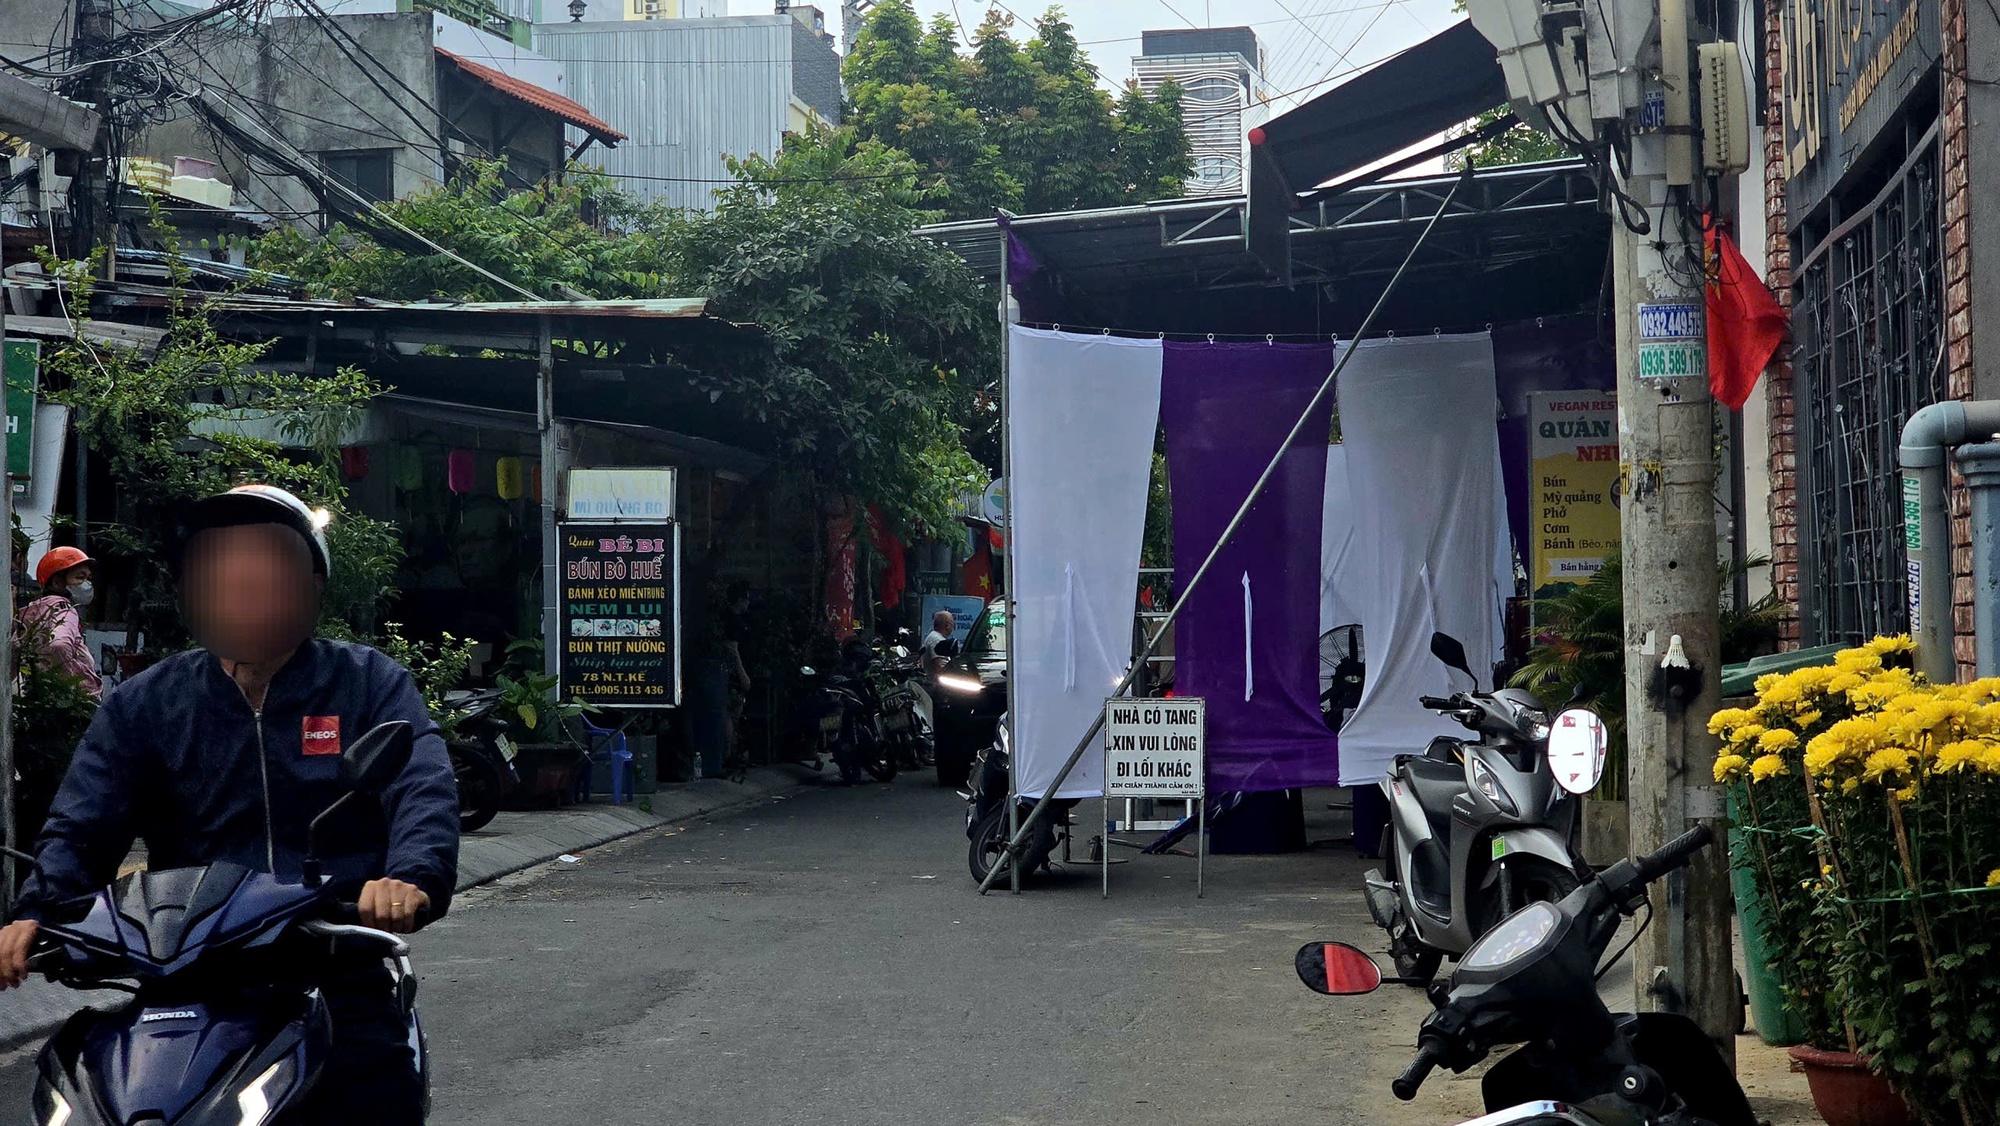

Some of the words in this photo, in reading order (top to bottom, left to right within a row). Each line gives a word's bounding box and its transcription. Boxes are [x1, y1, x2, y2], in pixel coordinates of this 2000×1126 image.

[1549, 401, 1589, 411] VEGAN
[1539, 416, 1610, 438] QUÁN
[1543, 475, 1566, 487] Bún
[1564, 490, 1602, 505] quảng
[1543, 506, 1567, 518] Phở
[1543, 523, 1569, 534] Cơm
[568, 535, 595, 548] Quán
[598, 535, 633, 553] BÉ
[636, 538, 664, 553] BI
[1543, 537, 1574, 549] Bánh
[567, 557, 601, 580] BÚN
[604, 557, 626, 580] BÒ
[630, 554, 665, 580] HUẾ
[1560, 562, 1577, 571] Bán
[568, 584, 594, 599] BÁNH
[570, 603, 618, 615] NEM
[626, 603, 662, 617] LỤI
[568, 638, 593, 653] BÚN
[596, 641, 622, 655] THỊT
[626, 638, 666, 653] NƯỚNG
[582, 672, 599, 682] 78
[644, 685, 664, 695] 436
[1113, 706, 1140, 724] NHÀ
[1144, 706, 1160, 724] CÓ
[1165, 709, 1196, 724] TANG
[305, 731, 337, 739] ENEOS
[1113, 735, 1135, 751] XIN
[1139, 735, 1159, 751] VUI
[1163, 732, 1196, 751] LÒNG
[1117, 762, 1130, 777] ĐI
[1134, 757, 1153, 777] LỐI
[1158, 759, 1191, 777] KHÁC
[143, 1011, 198, 1021] HONDA
